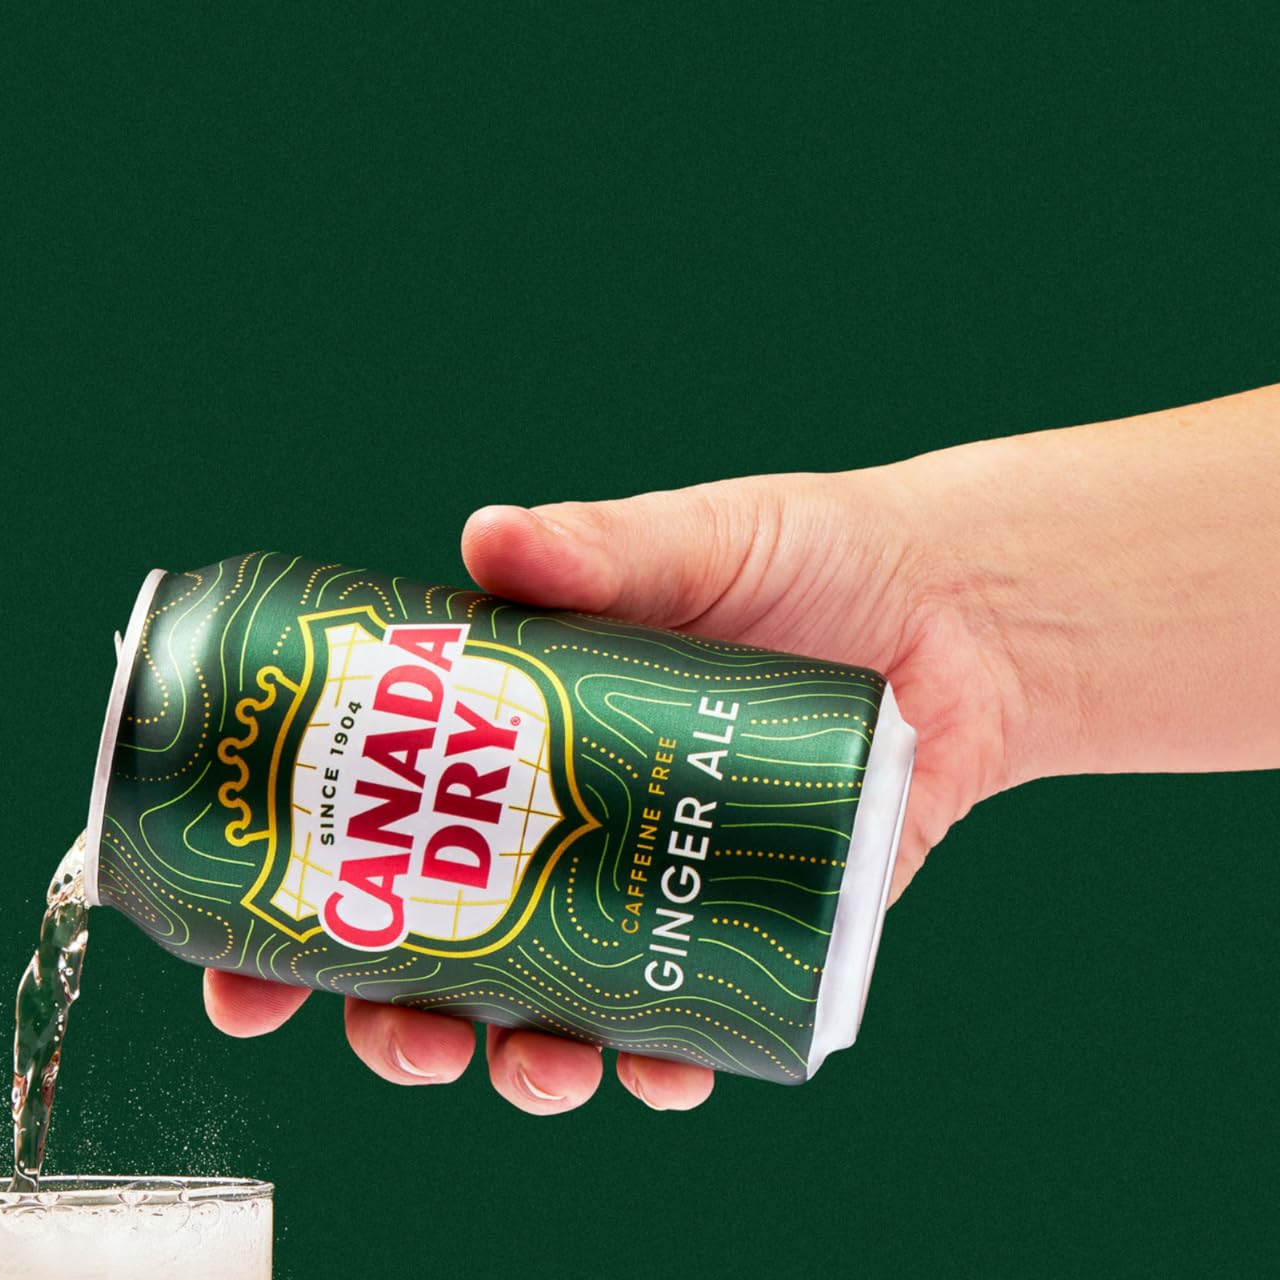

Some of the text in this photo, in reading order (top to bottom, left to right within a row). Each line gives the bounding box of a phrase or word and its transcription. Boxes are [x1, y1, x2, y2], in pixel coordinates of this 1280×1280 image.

[321, 700, 361, 846] SINCE 1904
[324, 627, 463, 947] CANADA
[622, 735, 677, 934] CAFFEINE FREE
[644, 696, 739, 992] GINGER ALE
